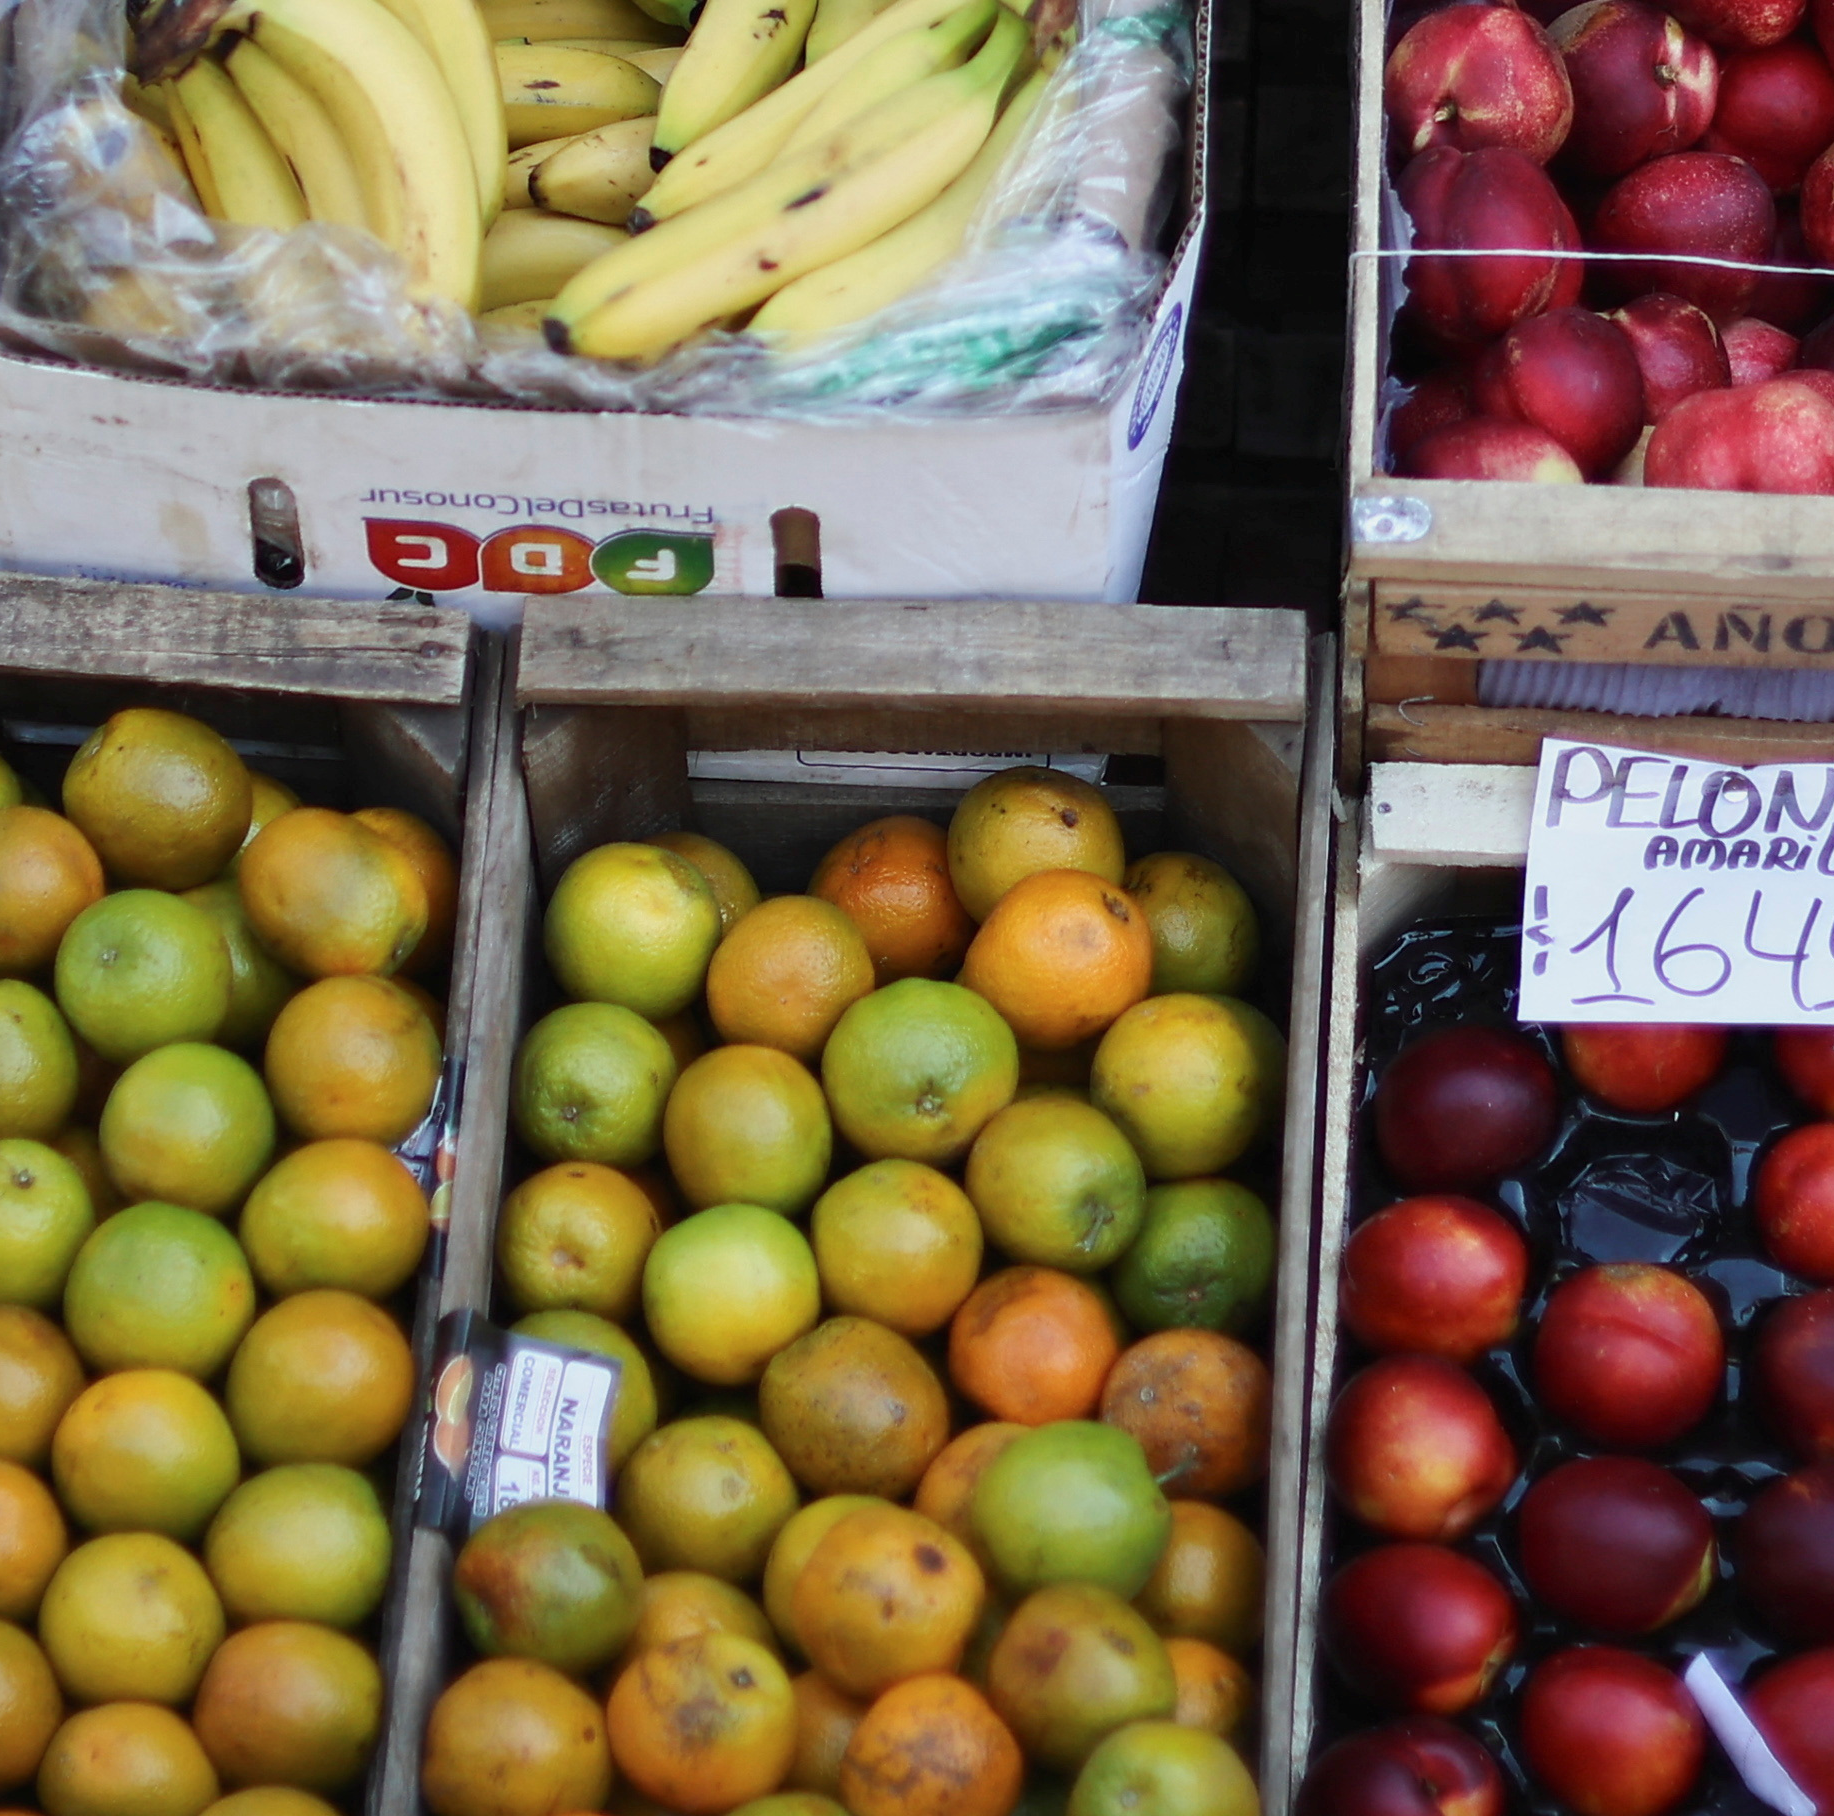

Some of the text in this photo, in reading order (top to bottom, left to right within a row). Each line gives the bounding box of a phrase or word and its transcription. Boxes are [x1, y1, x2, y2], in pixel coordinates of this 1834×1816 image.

[359, 487, 715, 525] FrutasDelConosur
[509, 1355, 536, 1450] COMERCIAL
[552, 1397, 580, 1498] NARANJ
[581, 1434, 595, 1487] ESPECIE
